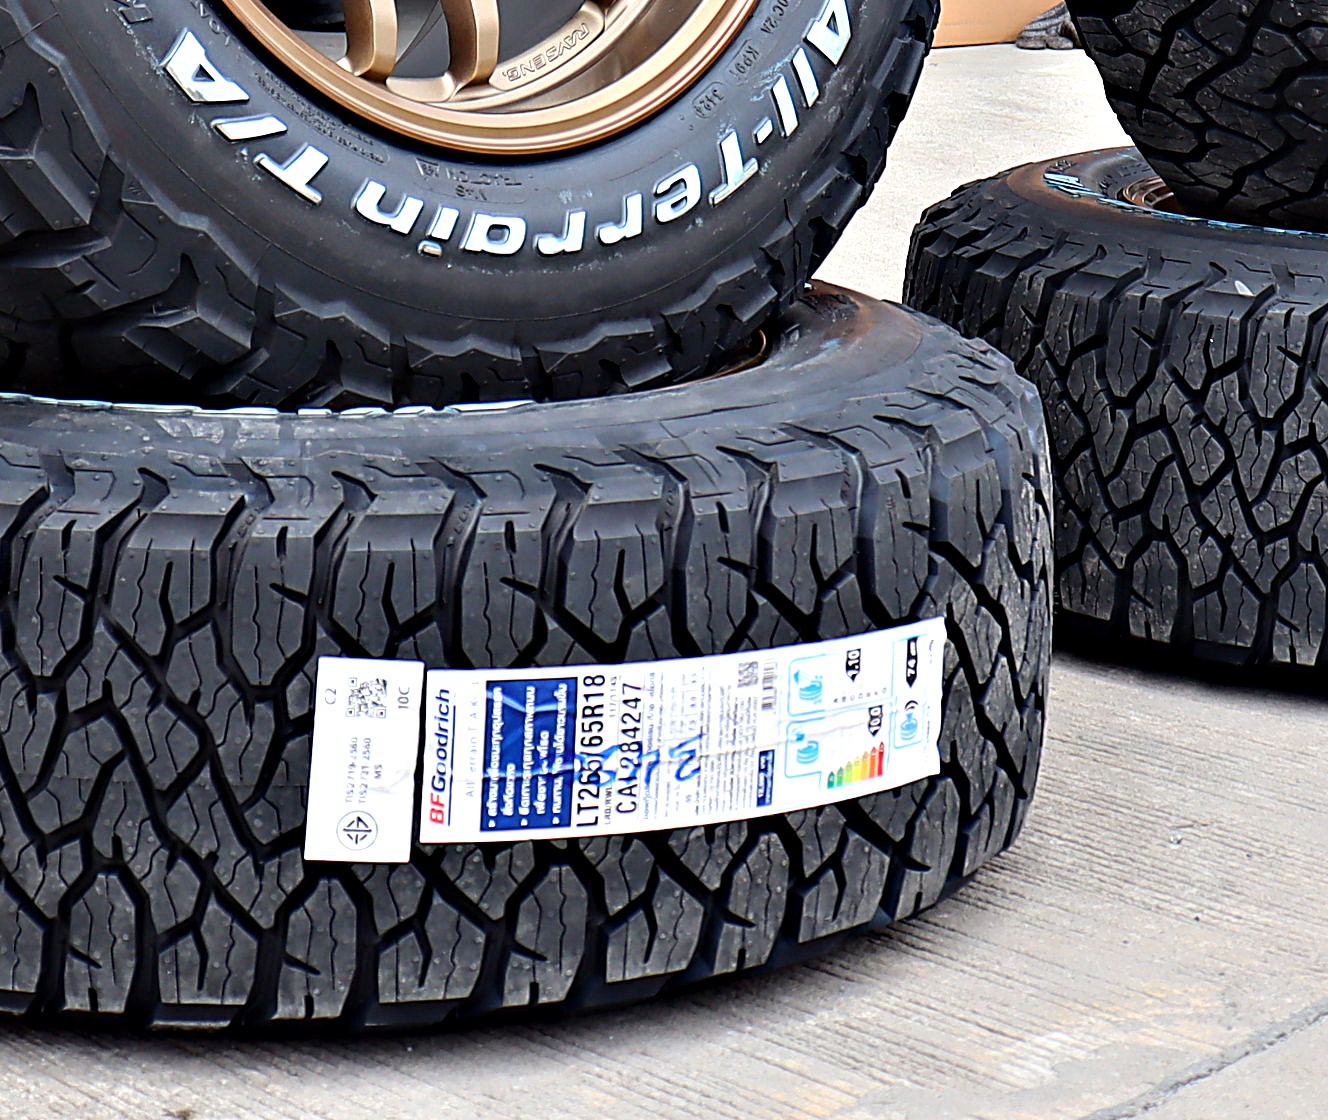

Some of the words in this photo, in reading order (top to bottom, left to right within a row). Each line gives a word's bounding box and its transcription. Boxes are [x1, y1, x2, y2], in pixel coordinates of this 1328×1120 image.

[160, 27, 333, 208] T/A
[324, 688, 337, 706] C2
[846, 650, 860, 678] 1.10
[428, 688, 450, 826] BFGoodrich
[575, 674, 607, 828] LT265/65R18
[616, 682, 643, 769] 284247
[373, 764, 383, 780] MS
